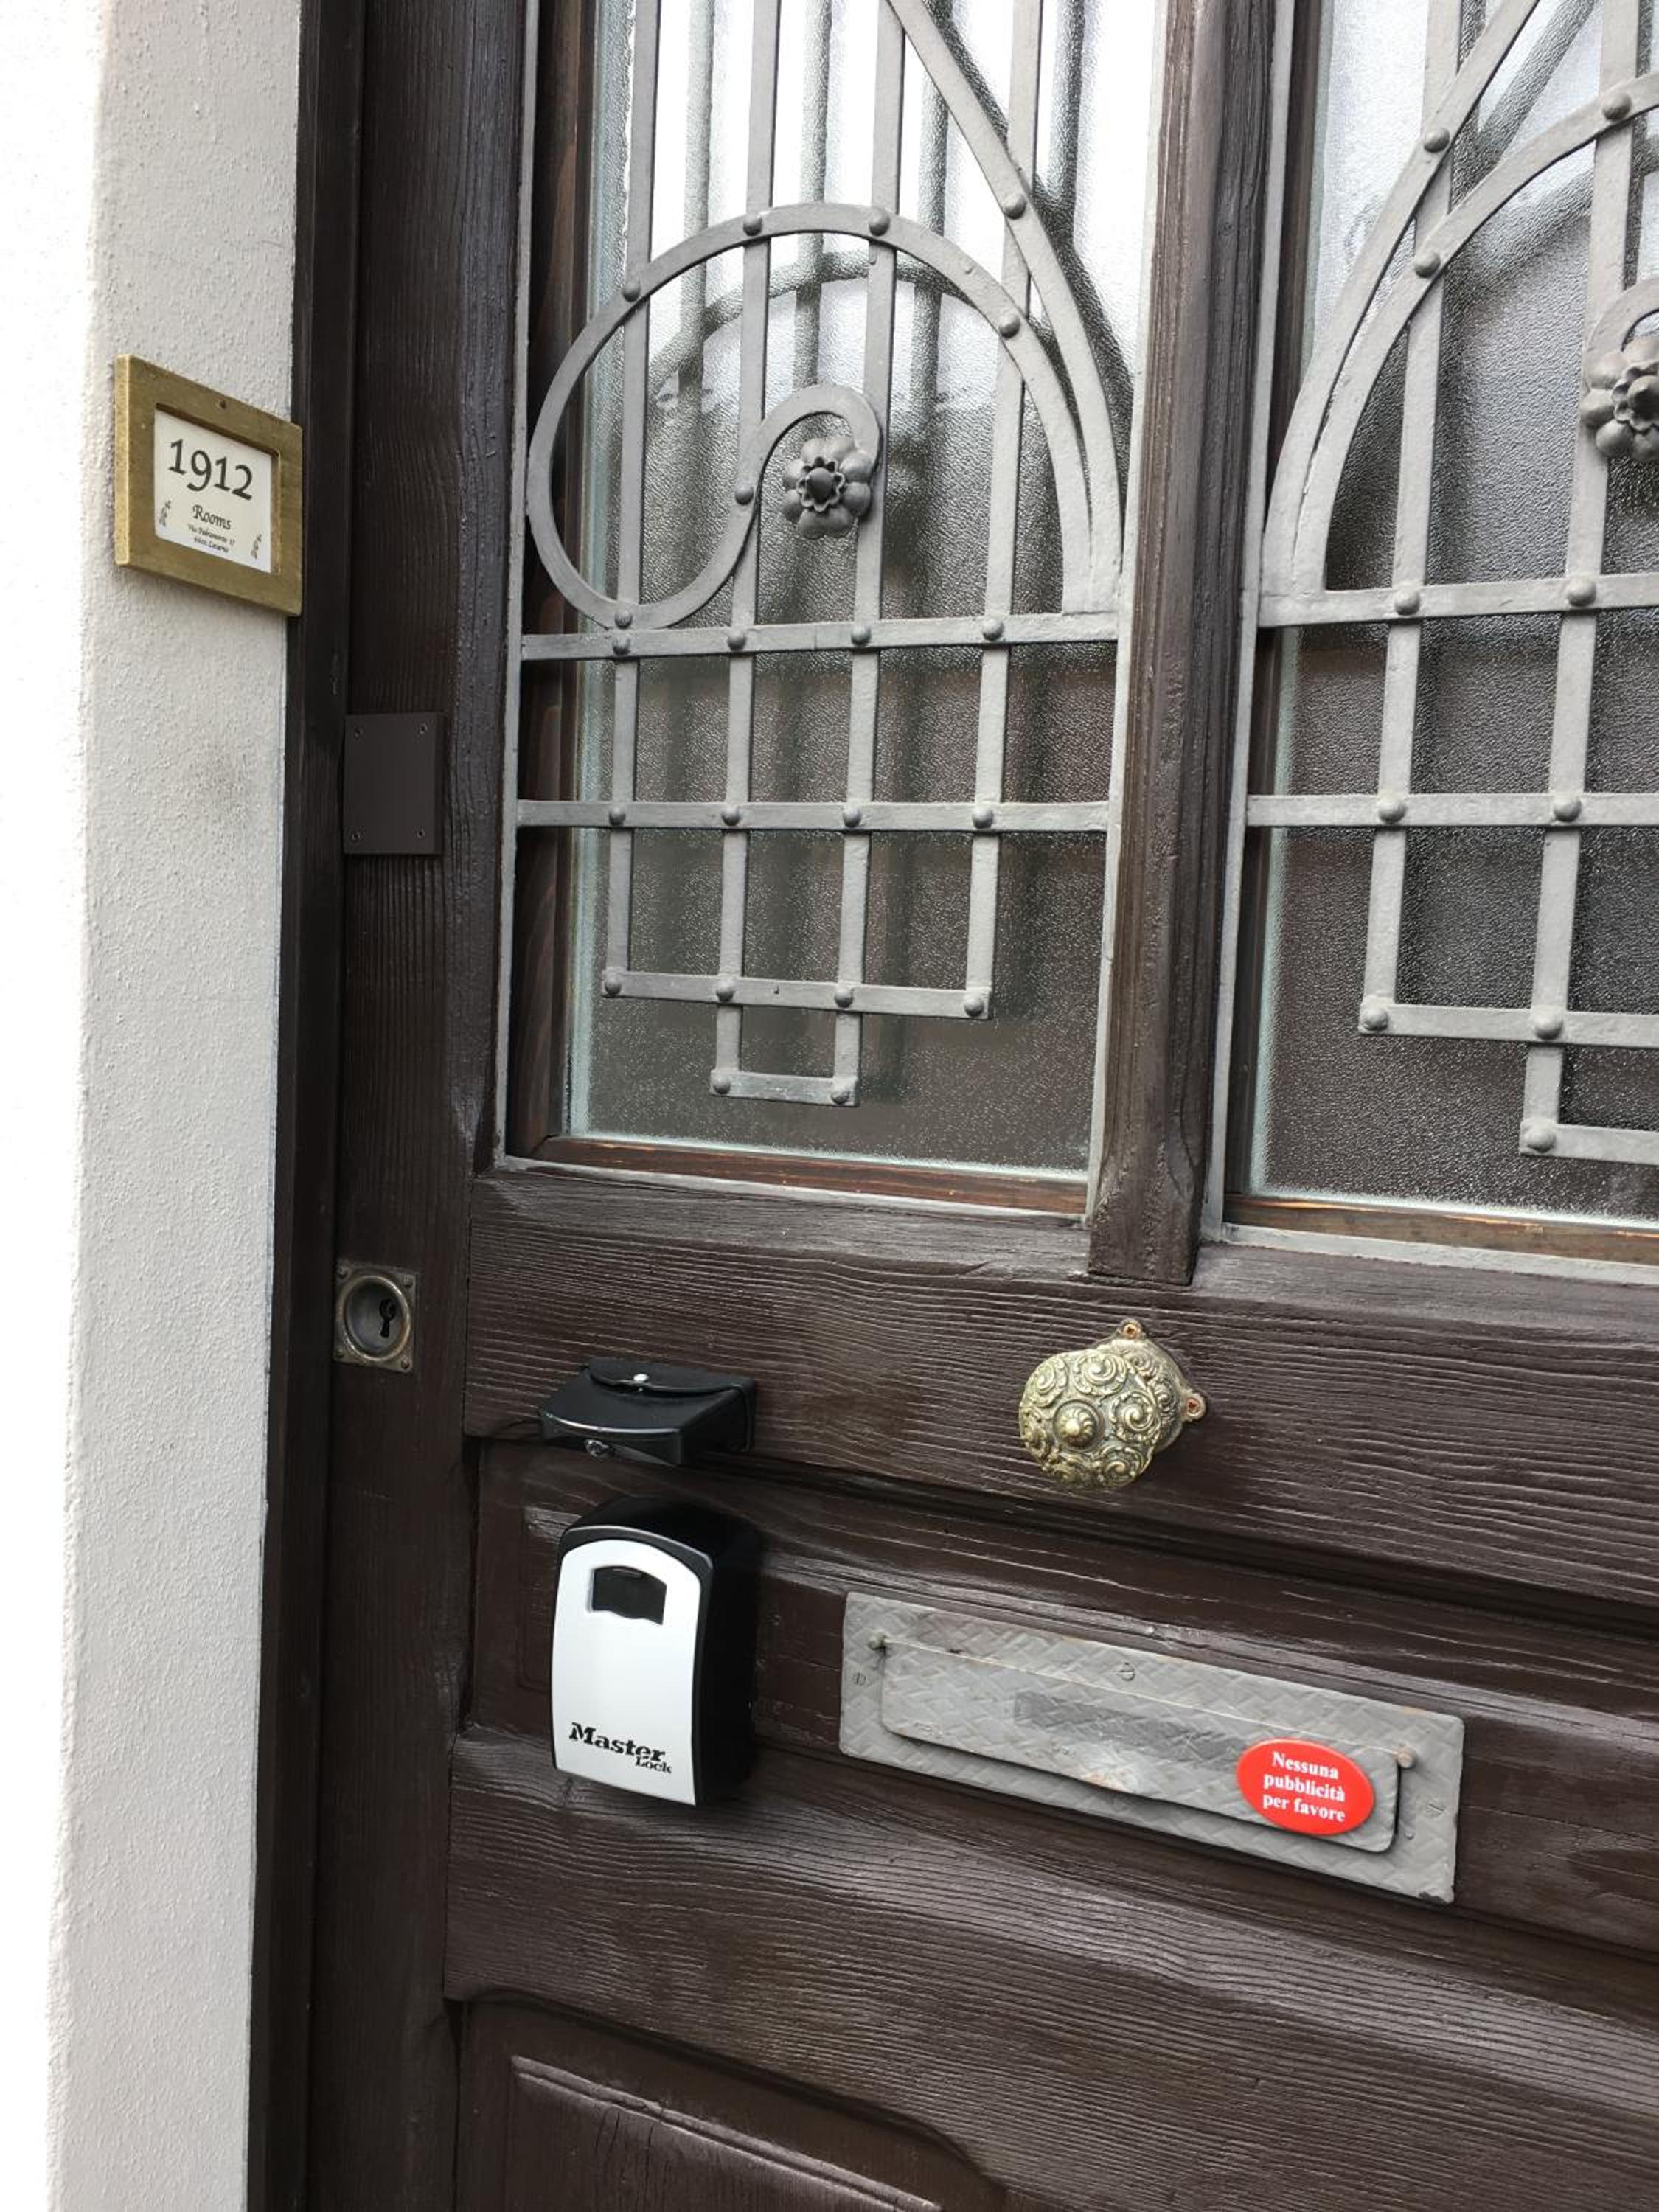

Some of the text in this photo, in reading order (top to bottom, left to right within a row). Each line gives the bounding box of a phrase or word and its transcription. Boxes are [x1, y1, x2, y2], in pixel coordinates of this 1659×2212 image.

[168, 439, 252, 501] 1912
[192, 504, 232, 530] Rooms
[569, 1722, 665, 1761] Master
[636, 1756, 672, 1773] Lock
[1272, 1751, 1339, 1780] Nessuna
[1264, 1773, 1346, 1802] pubblicità
[1262, 1794, 1346, 1822] per favore
